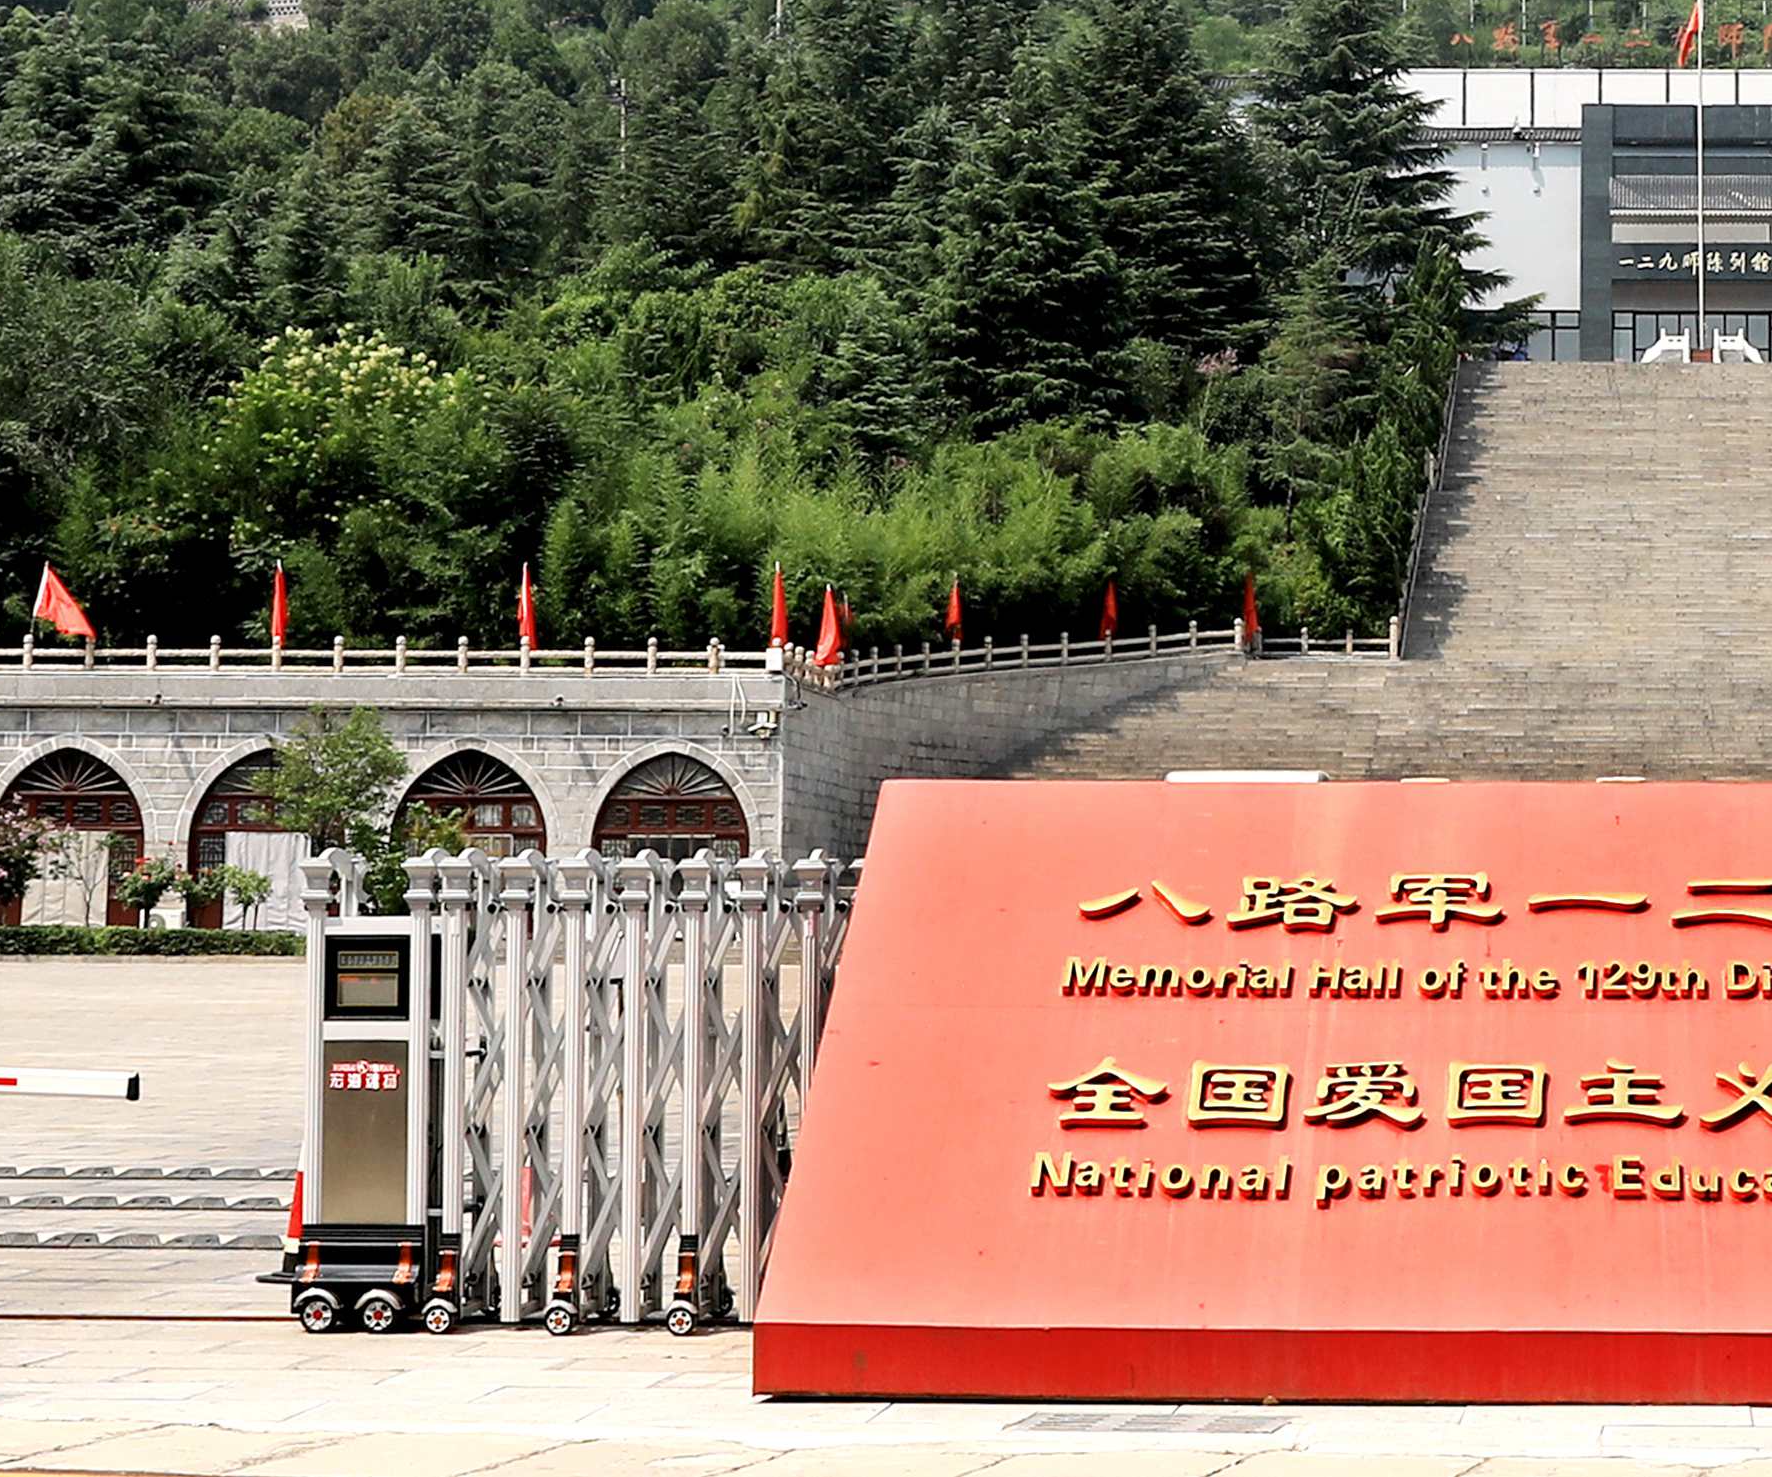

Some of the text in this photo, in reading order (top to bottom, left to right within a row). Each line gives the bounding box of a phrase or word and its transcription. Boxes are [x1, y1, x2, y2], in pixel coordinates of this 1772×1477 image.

[1061, 955, 1293, 998] Memorial
[1309, 957, 1404, 998] Hall
[1418, 959, 1469, 999] of
[1479, 957, 1561, 999] the
[1575, 957, 1711, 1001] 129th
[1029, 1150, 1293, 1201] National
[1313, 1153, 1588, 1209] patriotic
